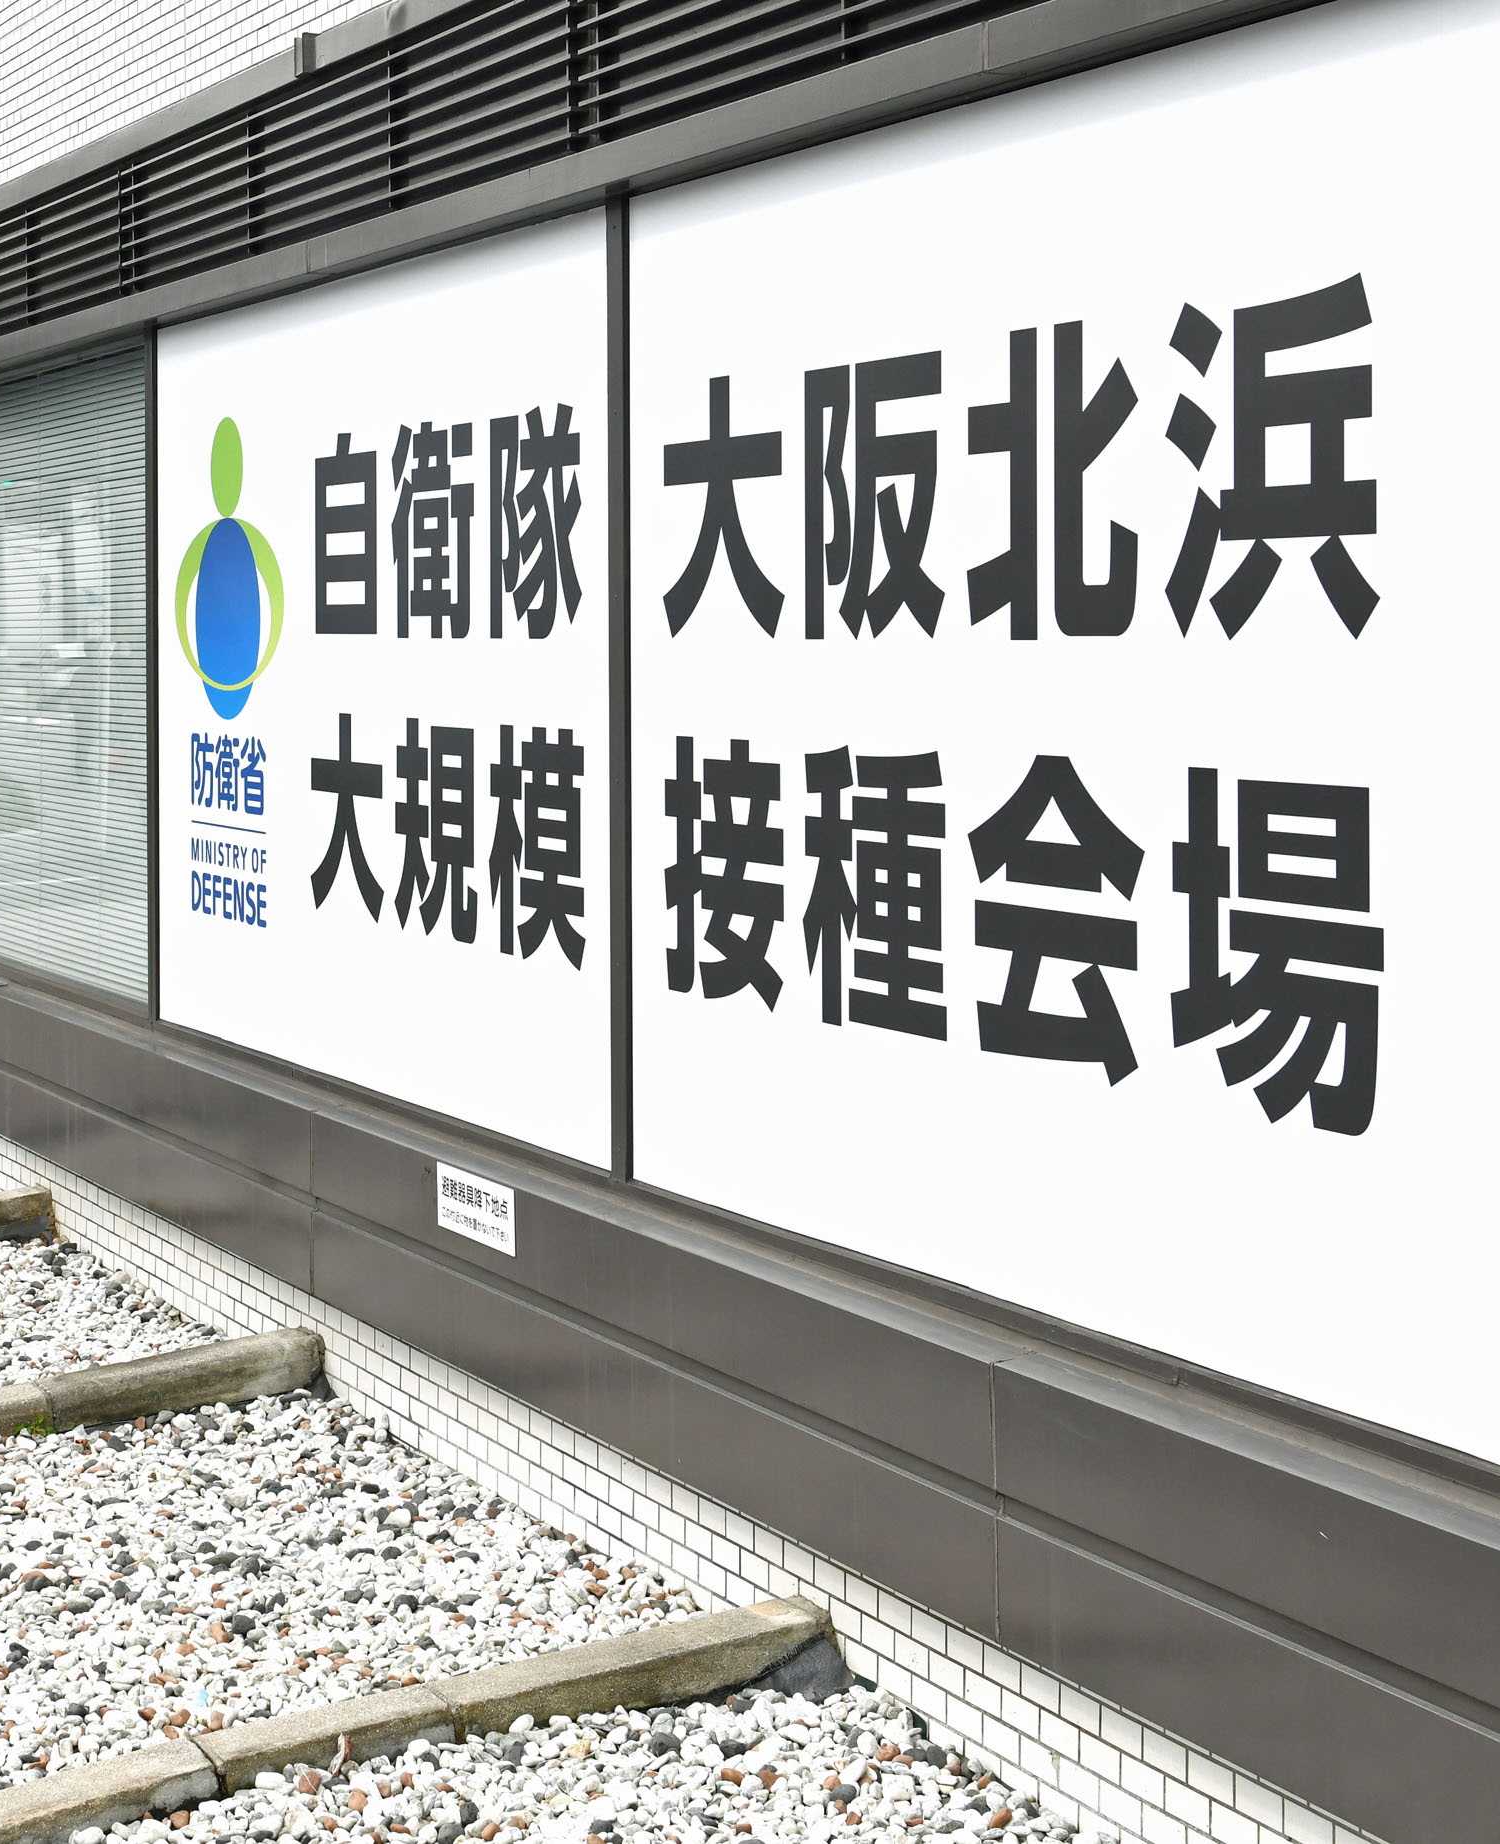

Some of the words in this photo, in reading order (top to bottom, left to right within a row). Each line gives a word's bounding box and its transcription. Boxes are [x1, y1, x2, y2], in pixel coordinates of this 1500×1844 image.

[314, 402, 583, 640] 自衛隊
[663, 273, 1380, 640] 大阪北浜
[191, 732, 266, 815] 防衛省
[191, 837, 247, 870] MINISTRY
[251, 848, 267, 874] OF
[310, 713, 586, 971] 大規模
[191, 870, 267, 928] DEFENSE
[664, 736, 1385, 1136] 接種会場
